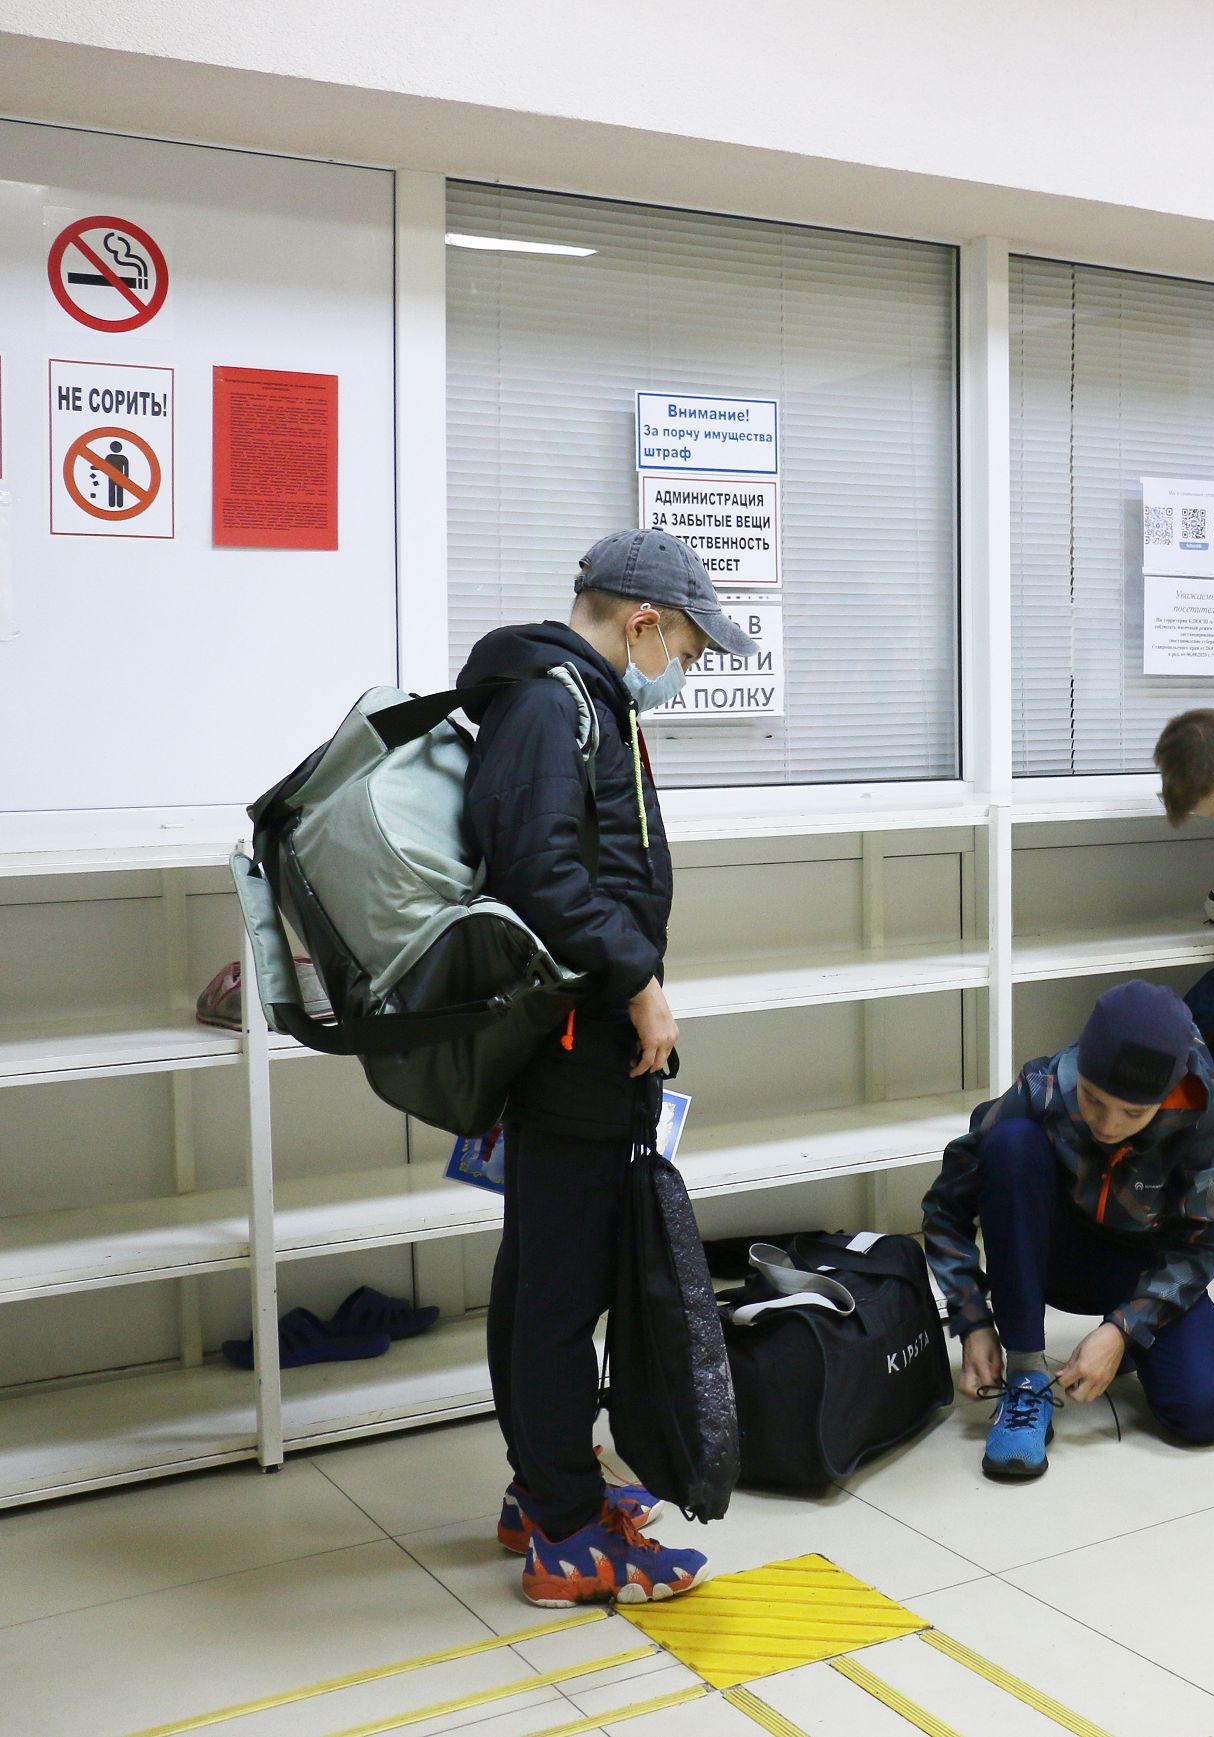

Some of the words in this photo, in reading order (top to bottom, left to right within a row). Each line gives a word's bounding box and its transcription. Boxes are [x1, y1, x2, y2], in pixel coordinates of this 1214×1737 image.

[58, 386, 82, 411] НЕ
[89, 388, 167, 417] СОРИТЬ!
[668, 404, 749, 422] Внимание!
[643, 424, 658, 436] За
[663, 427, 700, 441] порчу
[704, 430, 773, 443] имущества
[643, 446, 692, 461] штраф
[655, 490, 764, 509] АДМИНИСТРАЦИЯ
[652, 512, 667, 526] ЗА
[671, 513, 732, 528] ЗАБЫТЫЕ
[736, 515, 771, 530] ВЕЩИ
[749, 616, 762, 634] В
[757, 652, 772, 670] И
[694, 688, 775, 709] ПОЛКУ
[887, 1330, 930, 1374] KIPSTA
